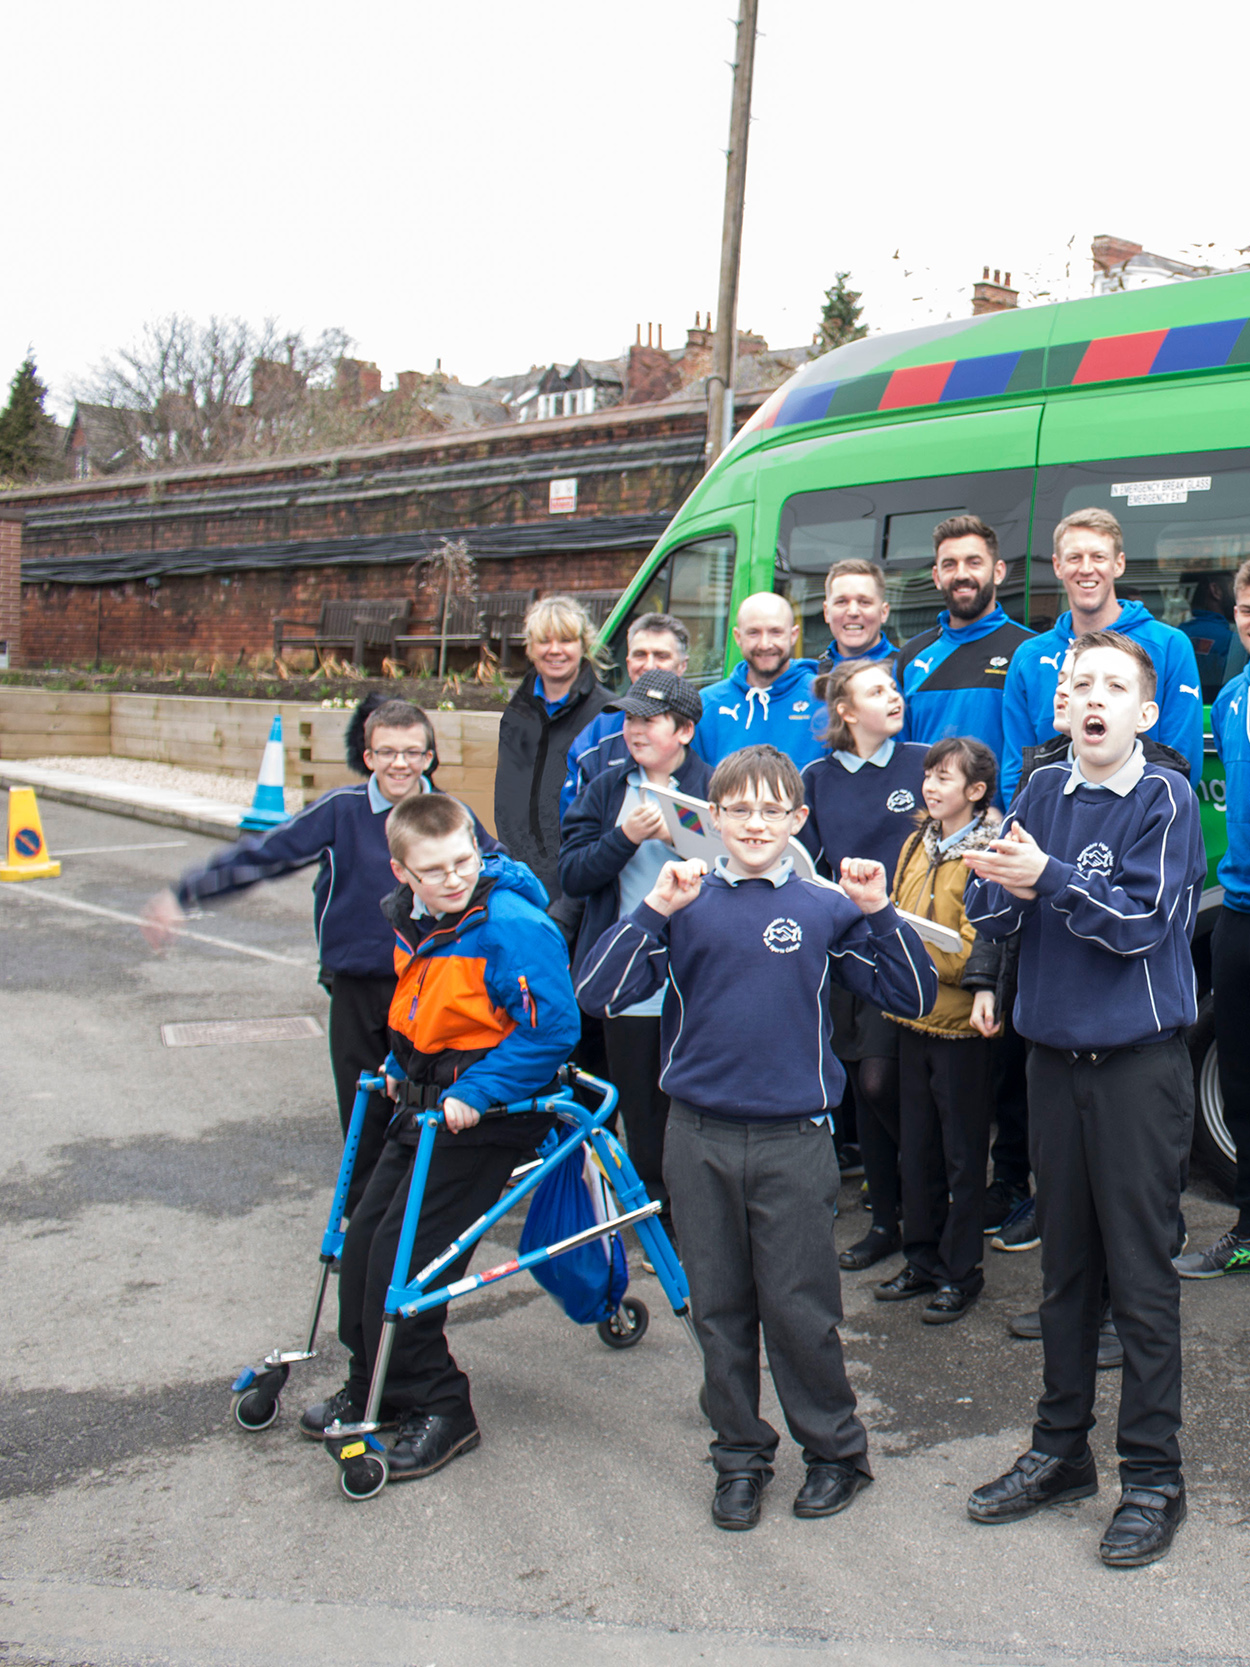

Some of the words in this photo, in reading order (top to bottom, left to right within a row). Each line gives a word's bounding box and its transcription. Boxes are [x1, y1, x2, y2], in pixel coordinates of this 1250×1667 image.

[1120, 482, 1160, 495] EMERGENCY
[1162, 480, 1185, 491] BREAK
[1187, 478, 1210, 490] GLASS
[1129, 493, 1170, 505] EMERGENCY
